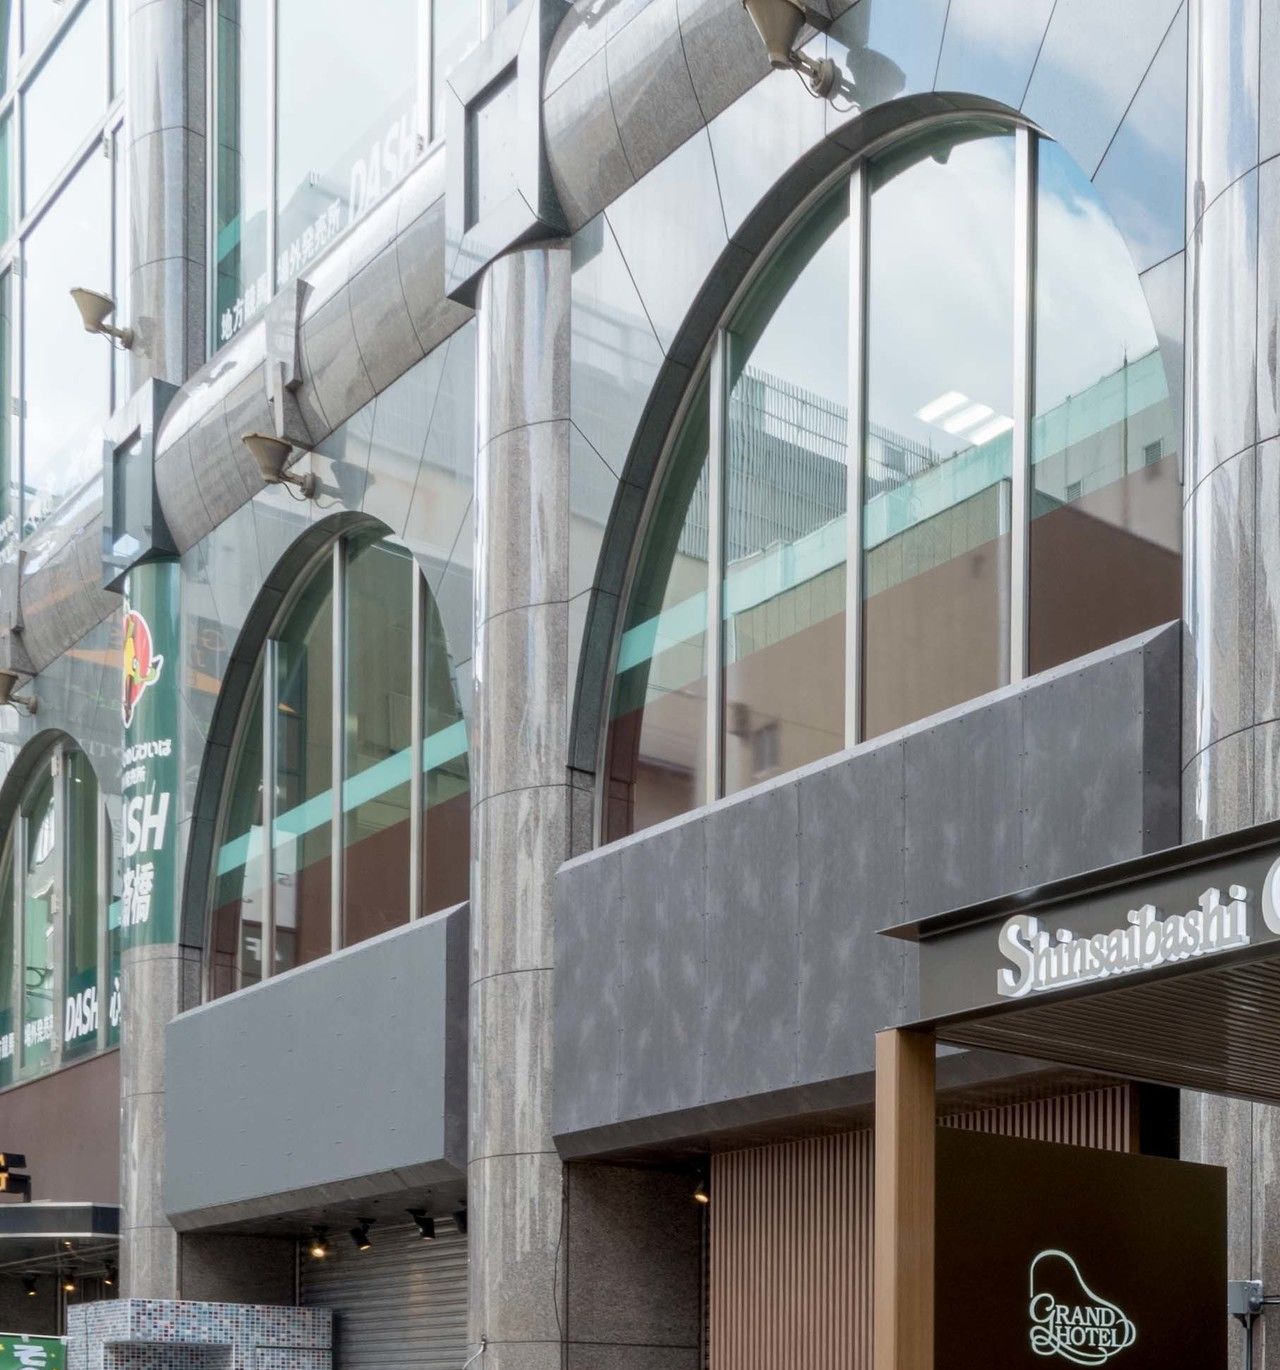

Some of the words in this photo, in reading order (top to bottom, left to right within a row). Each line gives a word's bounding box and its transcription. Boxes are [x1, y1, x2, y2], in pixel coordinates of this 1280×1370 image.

[997, 884, 1251, 998] Shinsaibashi
[64, 986, 99, 1042] DASH
[1029, 1293, 1117, 1328] GRAND
[1055, 1325, 1124, 1348] HOTEL
